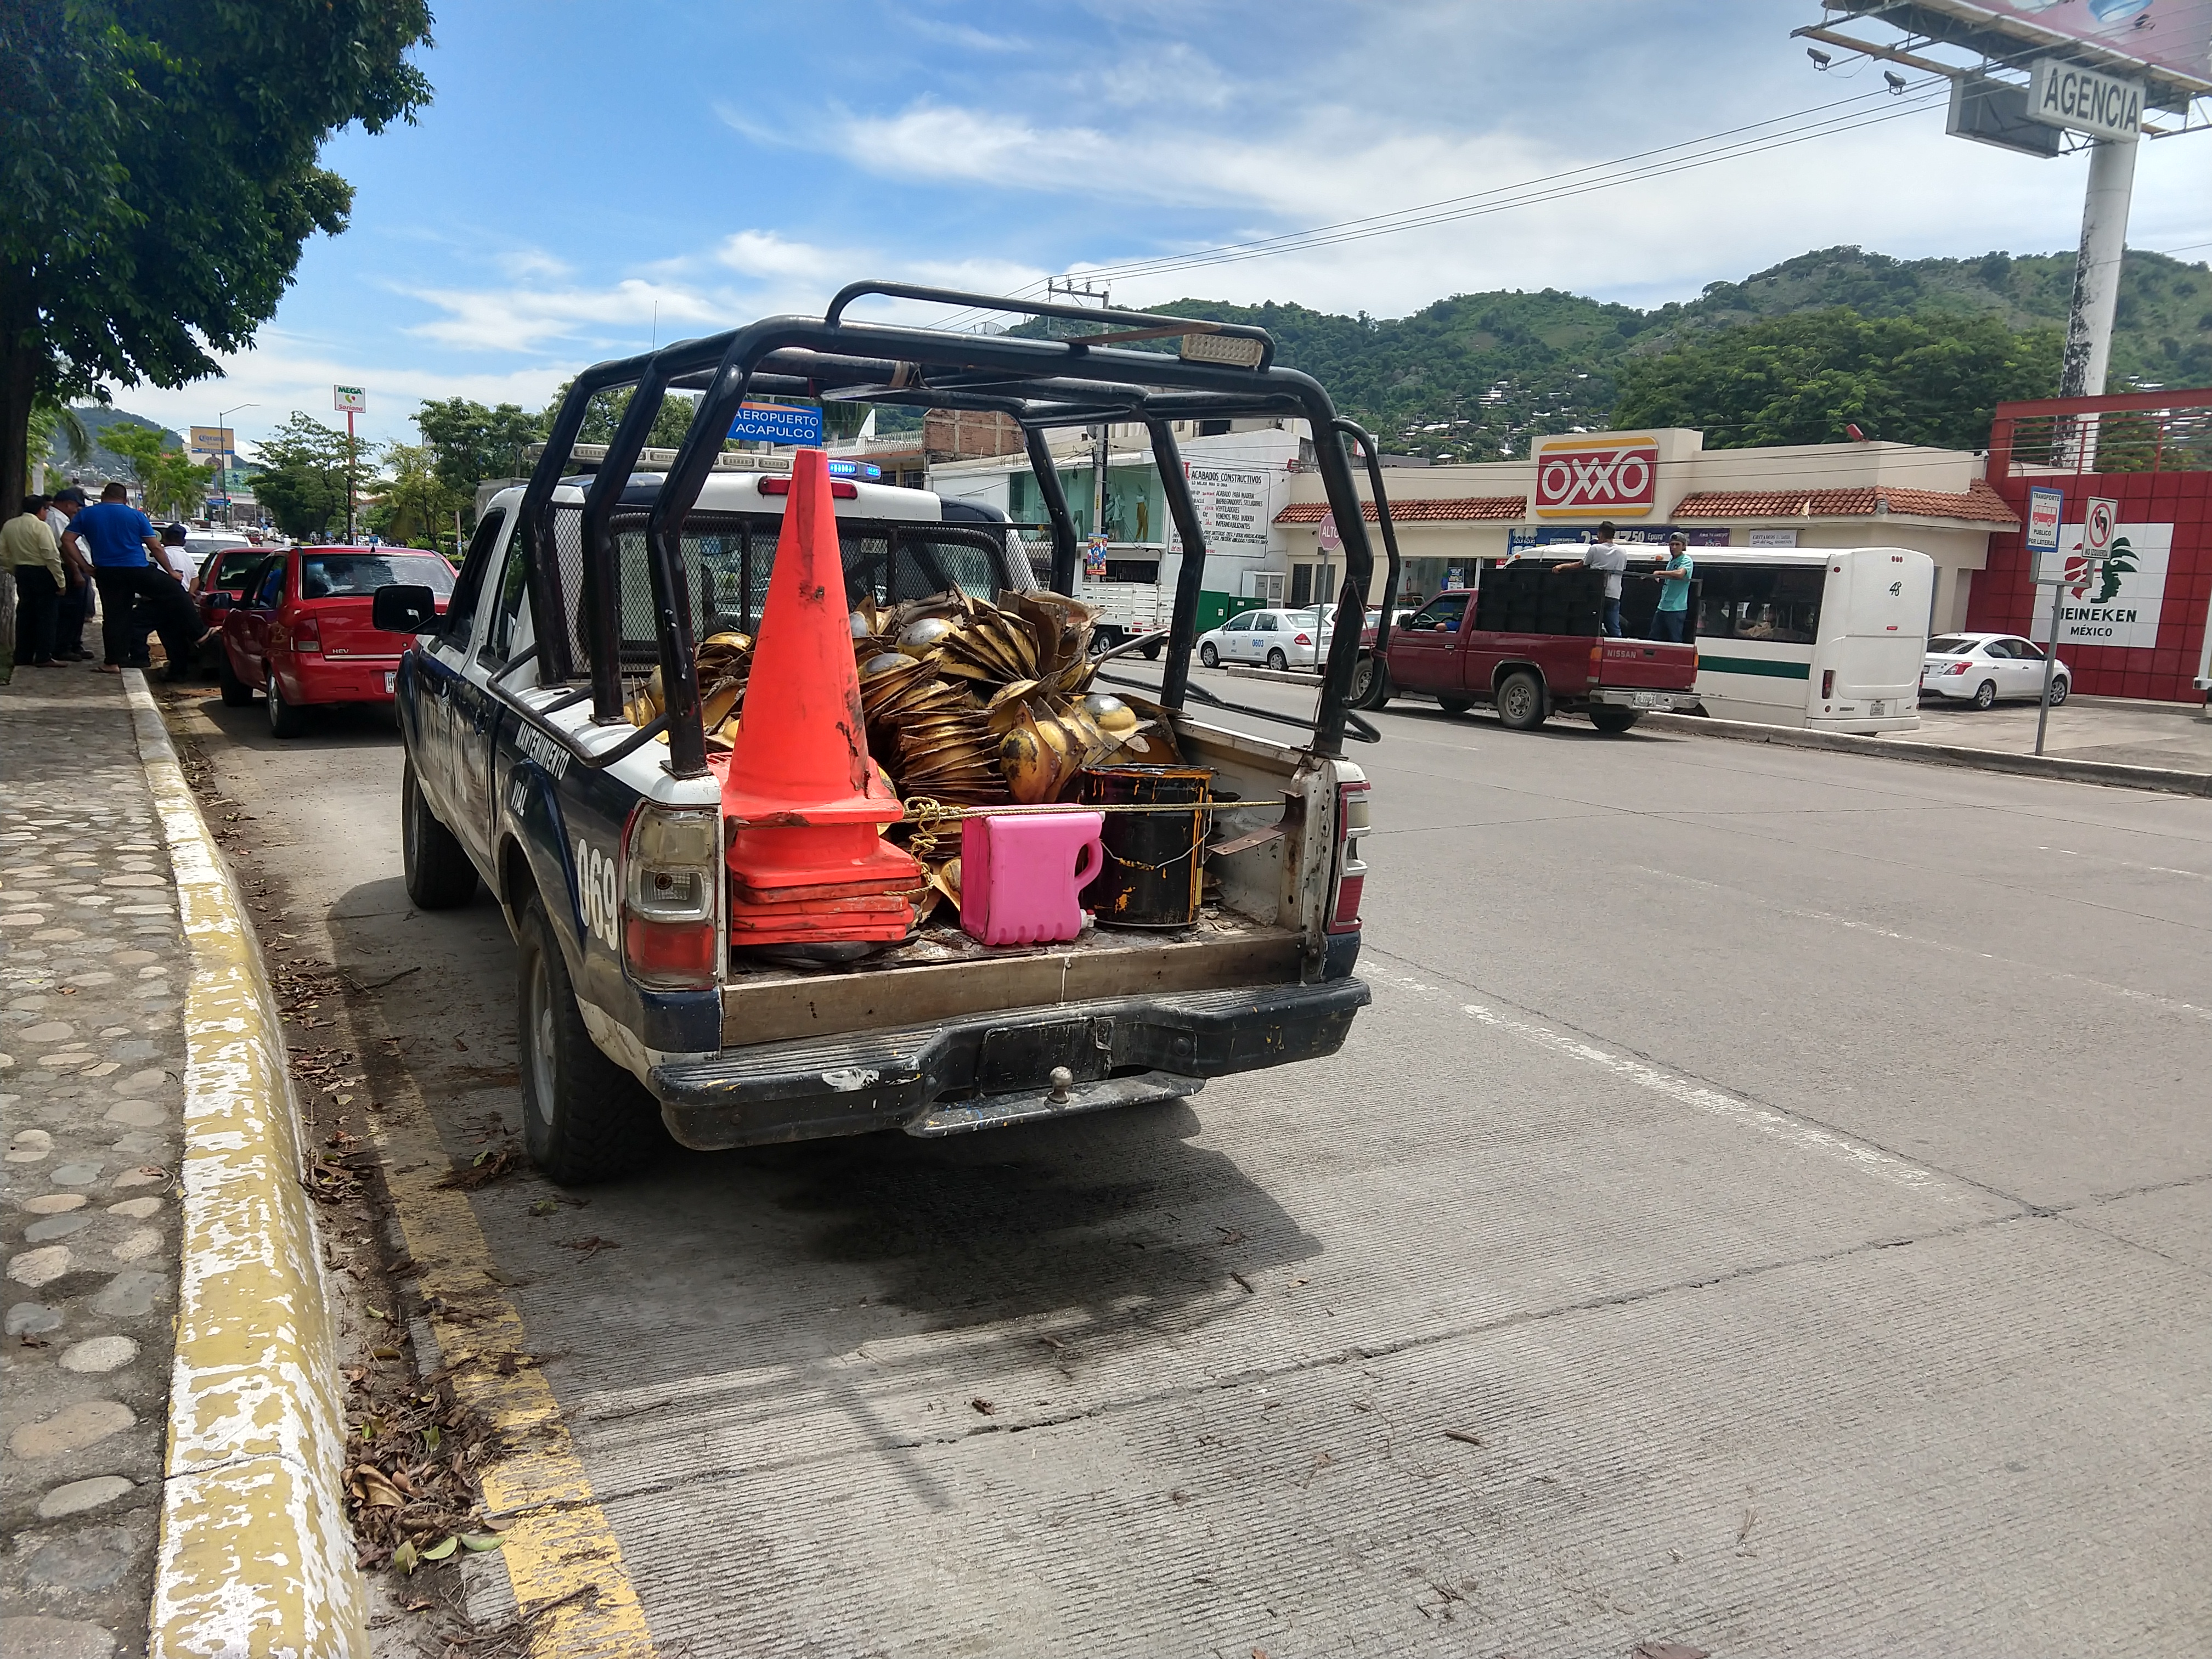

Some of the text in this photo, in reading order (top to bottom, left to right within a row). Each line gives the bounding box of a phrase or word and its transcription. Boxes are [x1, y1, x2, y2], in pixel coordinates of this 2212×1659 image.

[2044, 67, 2137, 133] AGENCIA
[338, 386, 363, 395] MEGA
[735, 424, 815, 439] ACAPULCO
[1191, 470, 1219, 481] ACABADOS
[1221, 472, 1262, 484] CONSTRUCTIVOS
[1542, 456, 1649, 500] OXXO
[2033, 493, 2060, 502] TRANSPORTE
[1215, 505, 1240, 513] VENTILADORES
[1889, 581, 1902, 596] 48
[2070, 624, 2113, 637] MÉXICO
[1252, 639, 1264, 647] 0603
[1607, 649, 1637, 658] NISSAN
[515, 721, 571, 781] MANTENIMIENTO
[511, 779, 528, 817] VIAL
[577, 838, 618, 951] 069
